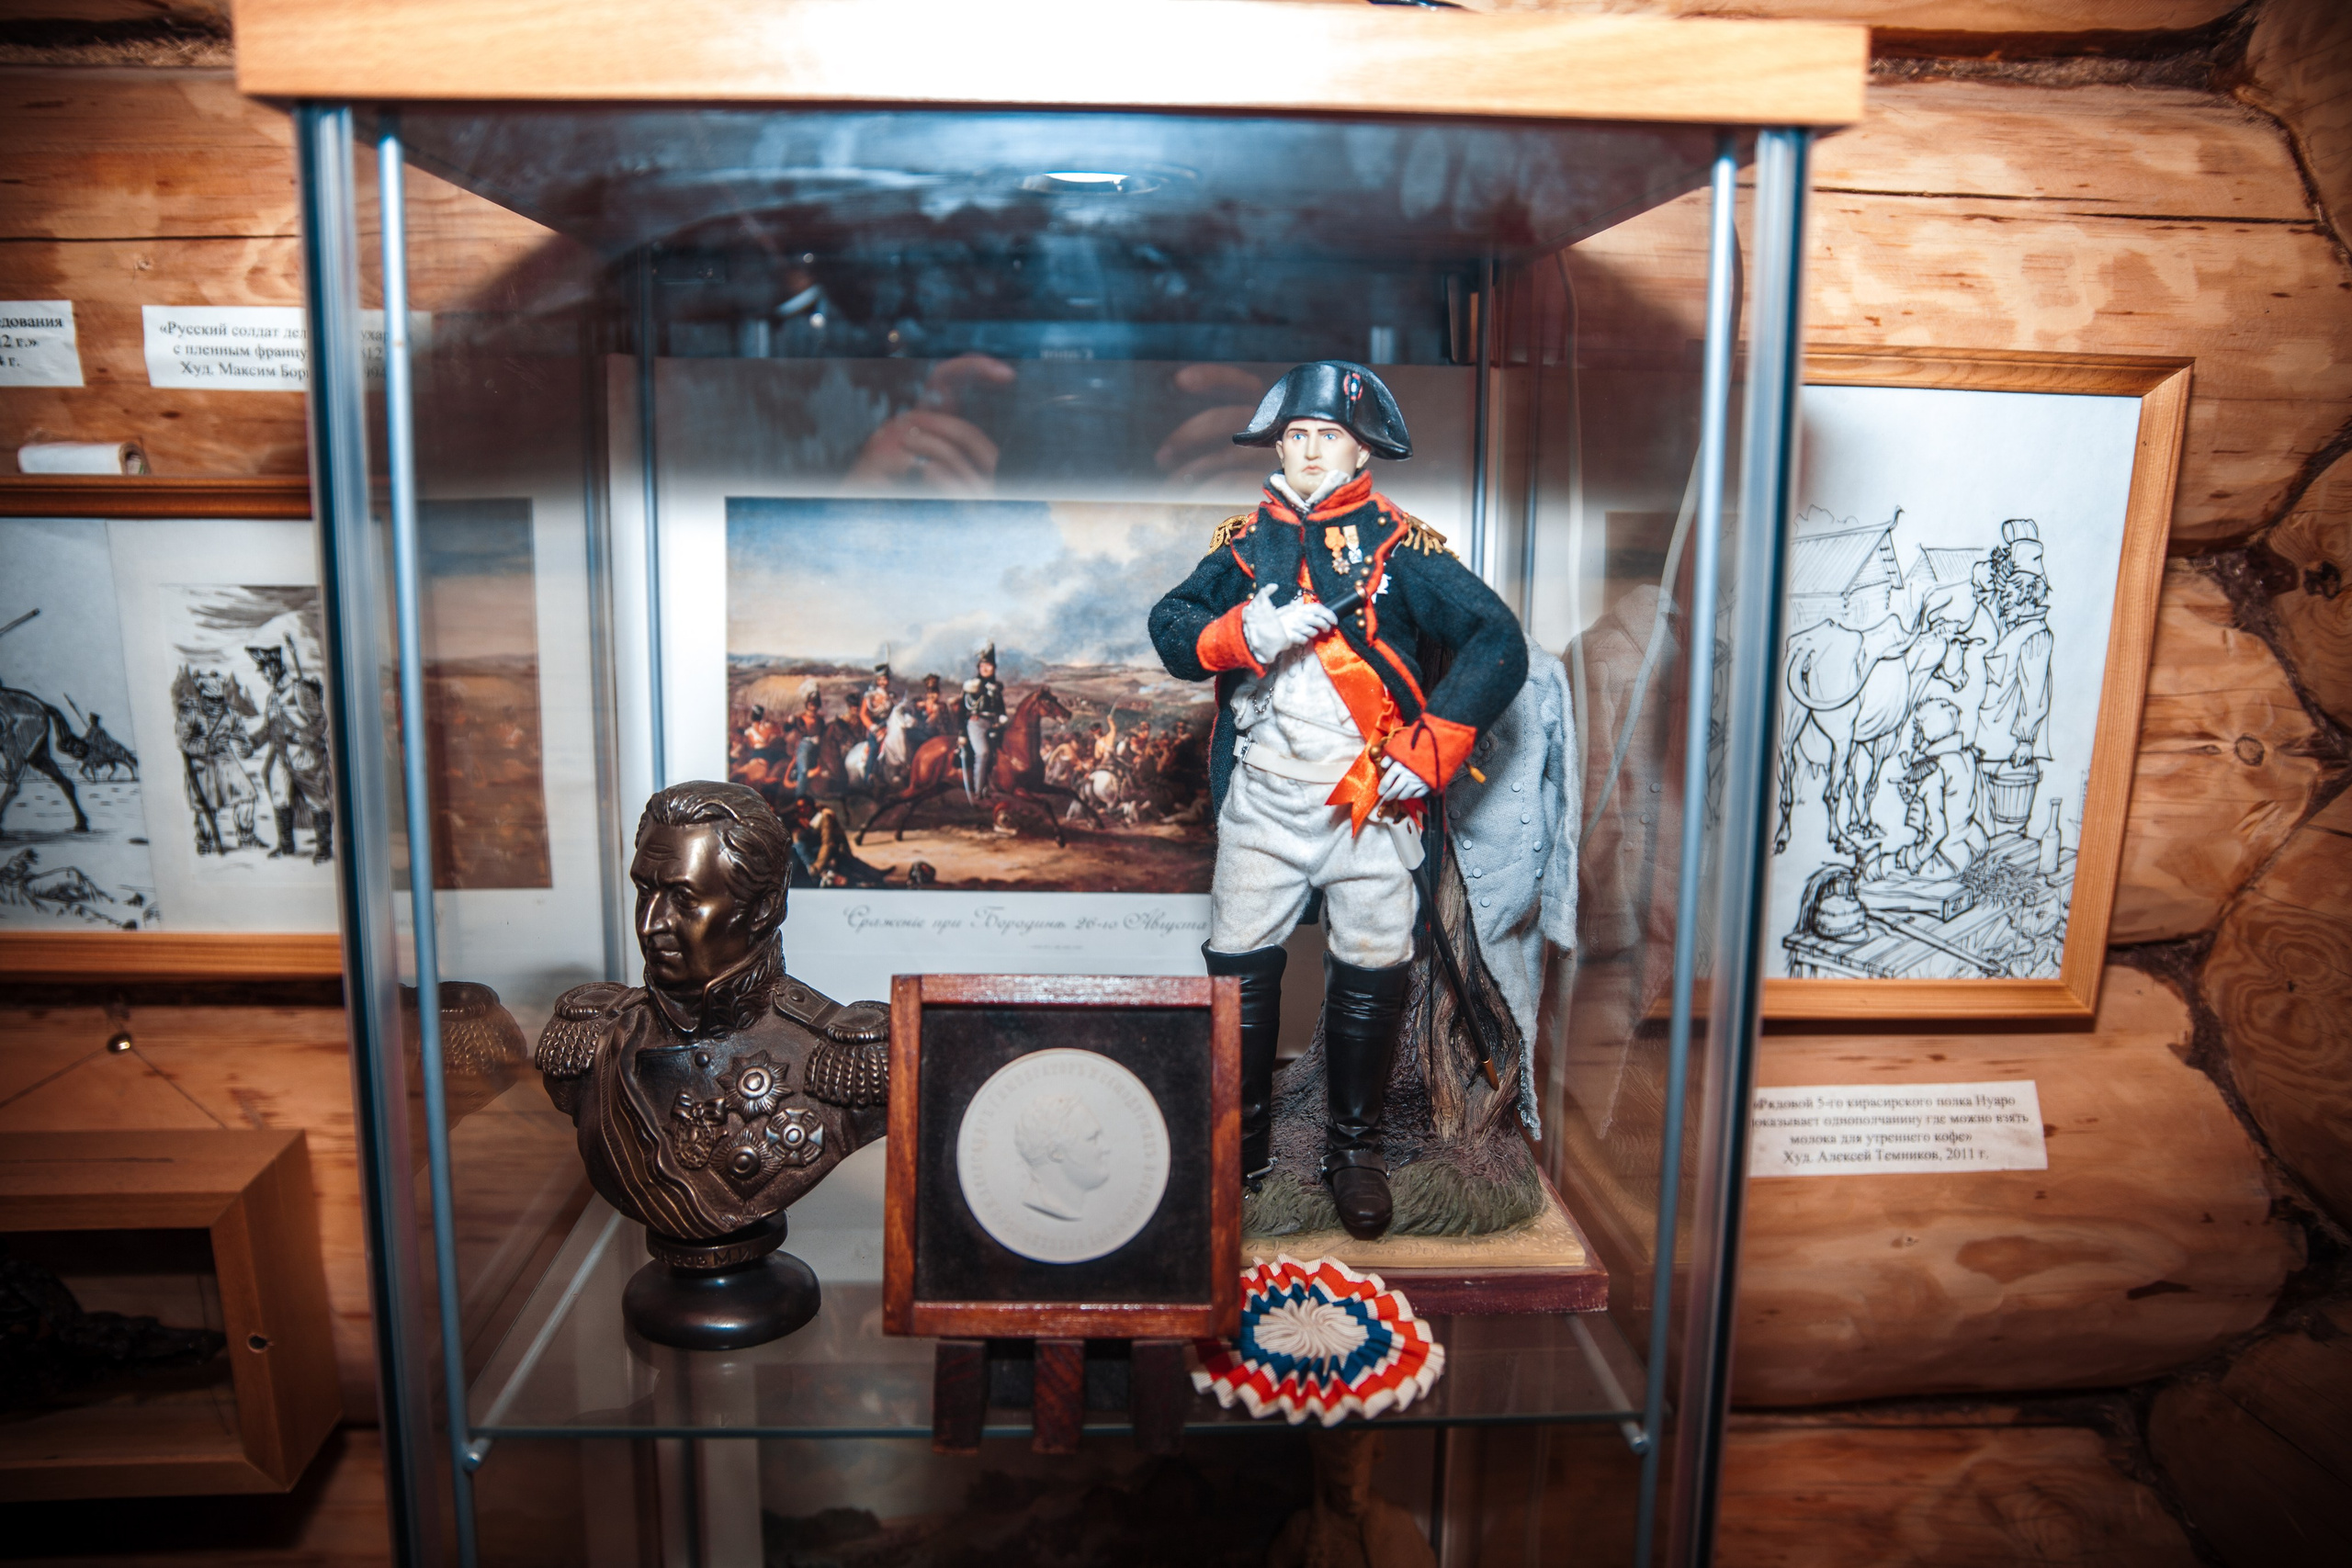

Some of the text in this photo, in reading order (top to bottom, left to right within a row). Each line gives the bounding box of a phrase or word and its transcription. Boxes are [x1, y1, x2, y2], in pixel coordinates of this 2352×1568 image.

[0, 318, 62, 328] дования
[160, 321, 227, 338] «Русский
[232, 327, 277, 338] солдат
[283, 330, 308, 339] дел
[0, 333, 38, 348] 2 г.»
[173, 345, 181, 355] с
[185, 345, 250, 356] пленным
[254, 344, 308, 360] францу
[180, 361, 214, 378] Худ.
[219, 362, 277, 378] Максим
[932, 918, 962, 935] при
[1123, 908, 1207, 938] Августа
[1847, 1097, 1932, 1111] кирасирского
[1936, 1098, 1972, 1108] полка
[1975, 1094, 2016, 1110] Нуаро
[1824, 1115, 1922, 1128] однополчанину
[1925, 1116, 1947, 1126] где
[1950, 1115, 1992, 1124] можно
[1996, 1114, 2029, 1124] взять
[1790, 1130, 1973, 1146] молока для утреннего кофе»
[1783, 1150, 1813, 1167] Худ.
[1818, 1149, 1871, 1163] Алексей
[1875, 1148, 1943, 1162] Темников,
[1946, 1147, 1973, 1160] 2011
